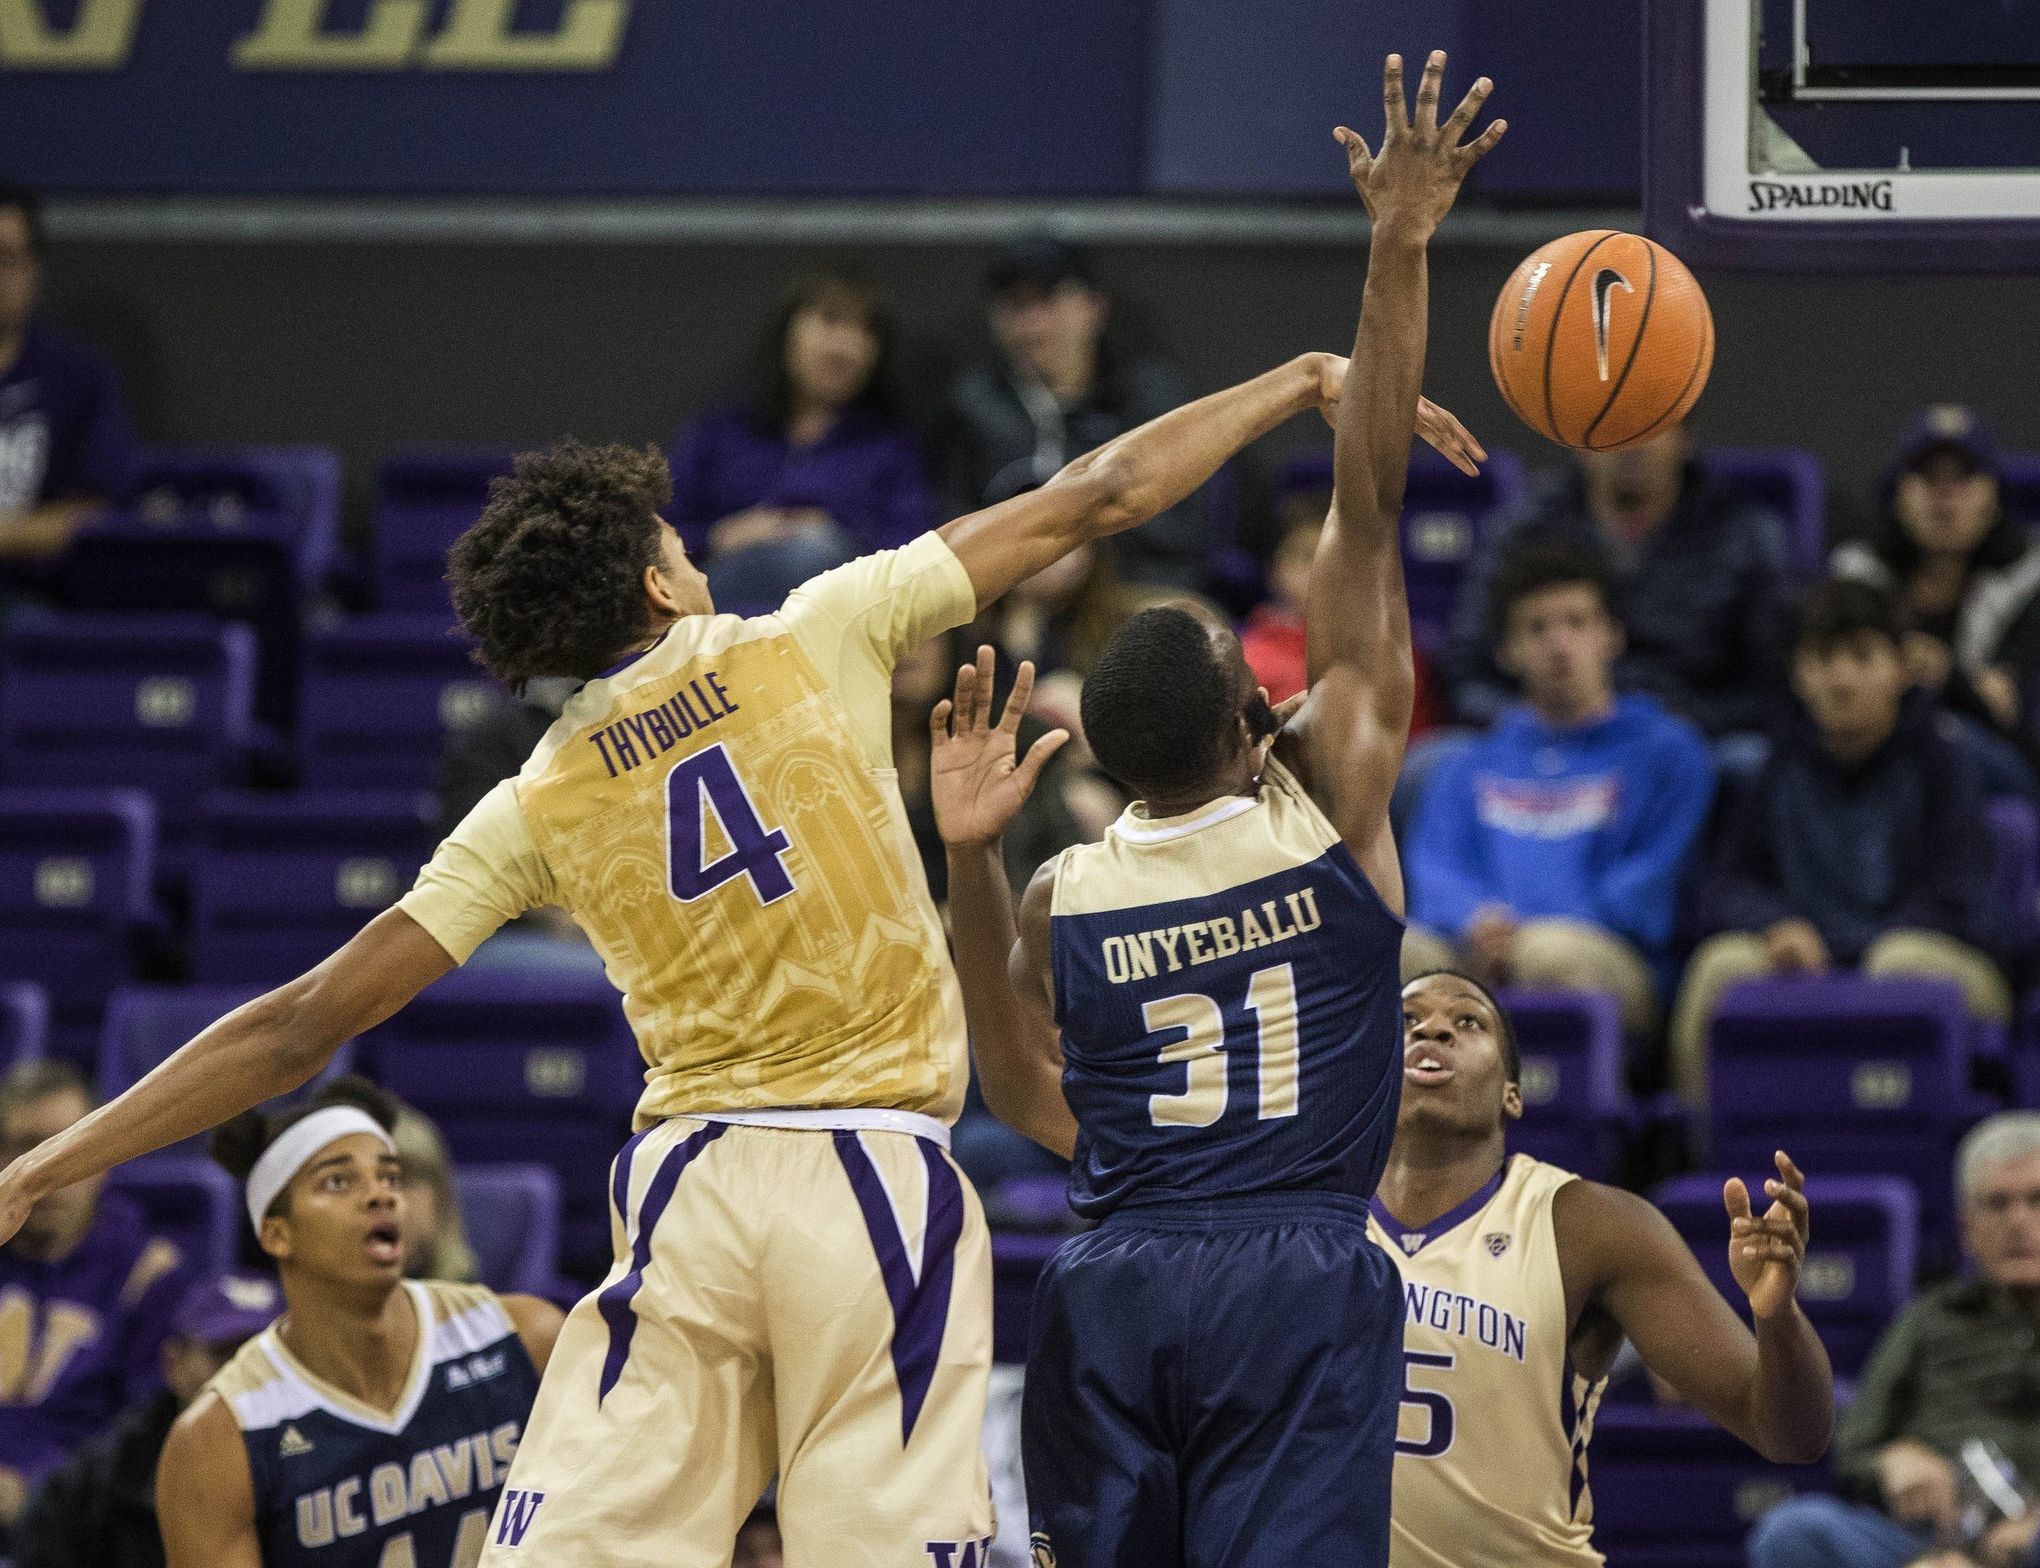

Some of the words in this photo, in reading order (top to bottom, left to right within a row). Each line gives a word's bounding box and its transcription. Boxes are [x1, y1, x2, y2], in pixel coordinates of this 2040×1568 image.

[1749, 180, 1894, 212] SPALDING
[588, 671, 740, 778] THYBULLE
[664, 741, 799, 908] 4
[1101, 887, 1322, 985] ONYEBALU
[1141, 962, 1300, 1128] 31
[296, 1474, 368, 1549] UC
[369, 1420, 521, 1527] DAVIS
[494, 1489, 546, 1548] W
